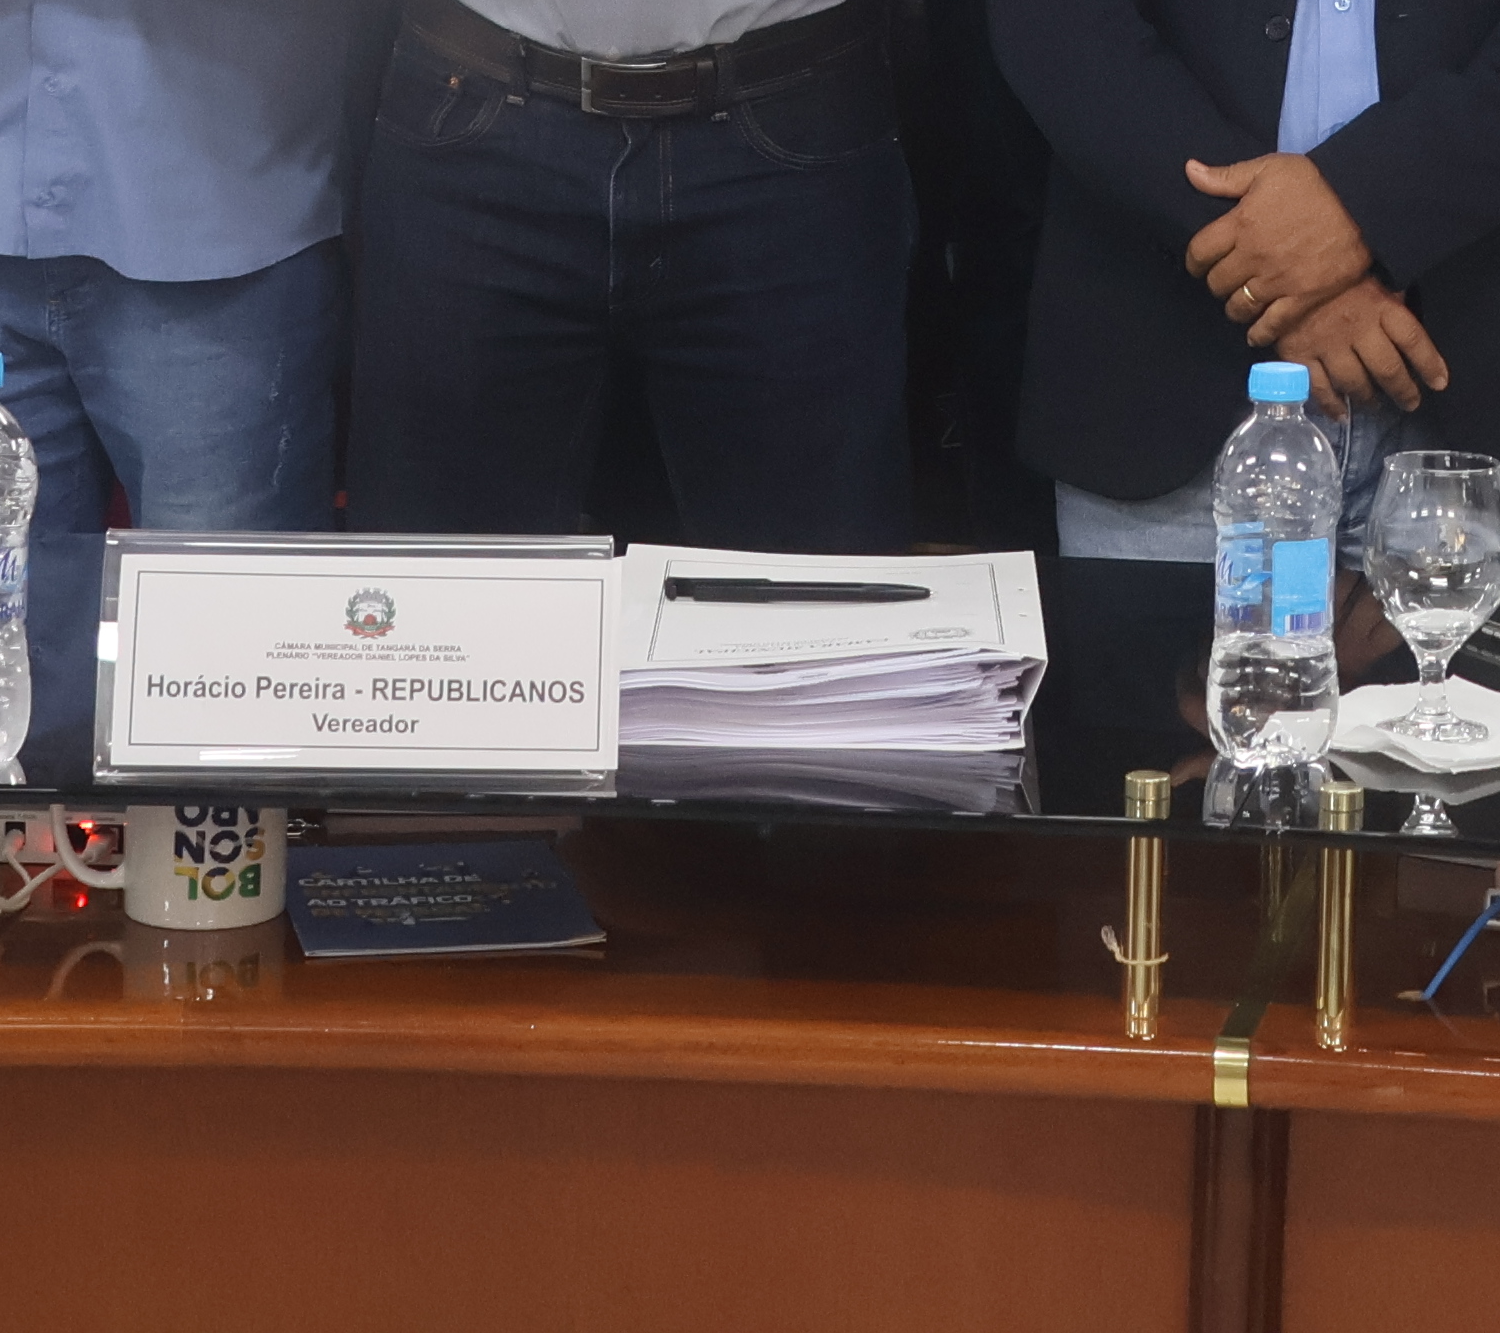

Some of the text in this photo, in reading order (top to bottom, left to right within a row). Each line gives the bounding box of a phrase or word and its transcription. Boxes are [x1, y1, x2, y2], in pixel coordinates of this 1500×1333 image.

[147, 674, 246, 698] Horácio
[256, 676, 344, 701] Pereira
[372, 678, 584, 703] REPUBLICANOS
[312, 713, 419, 734] Vereador
